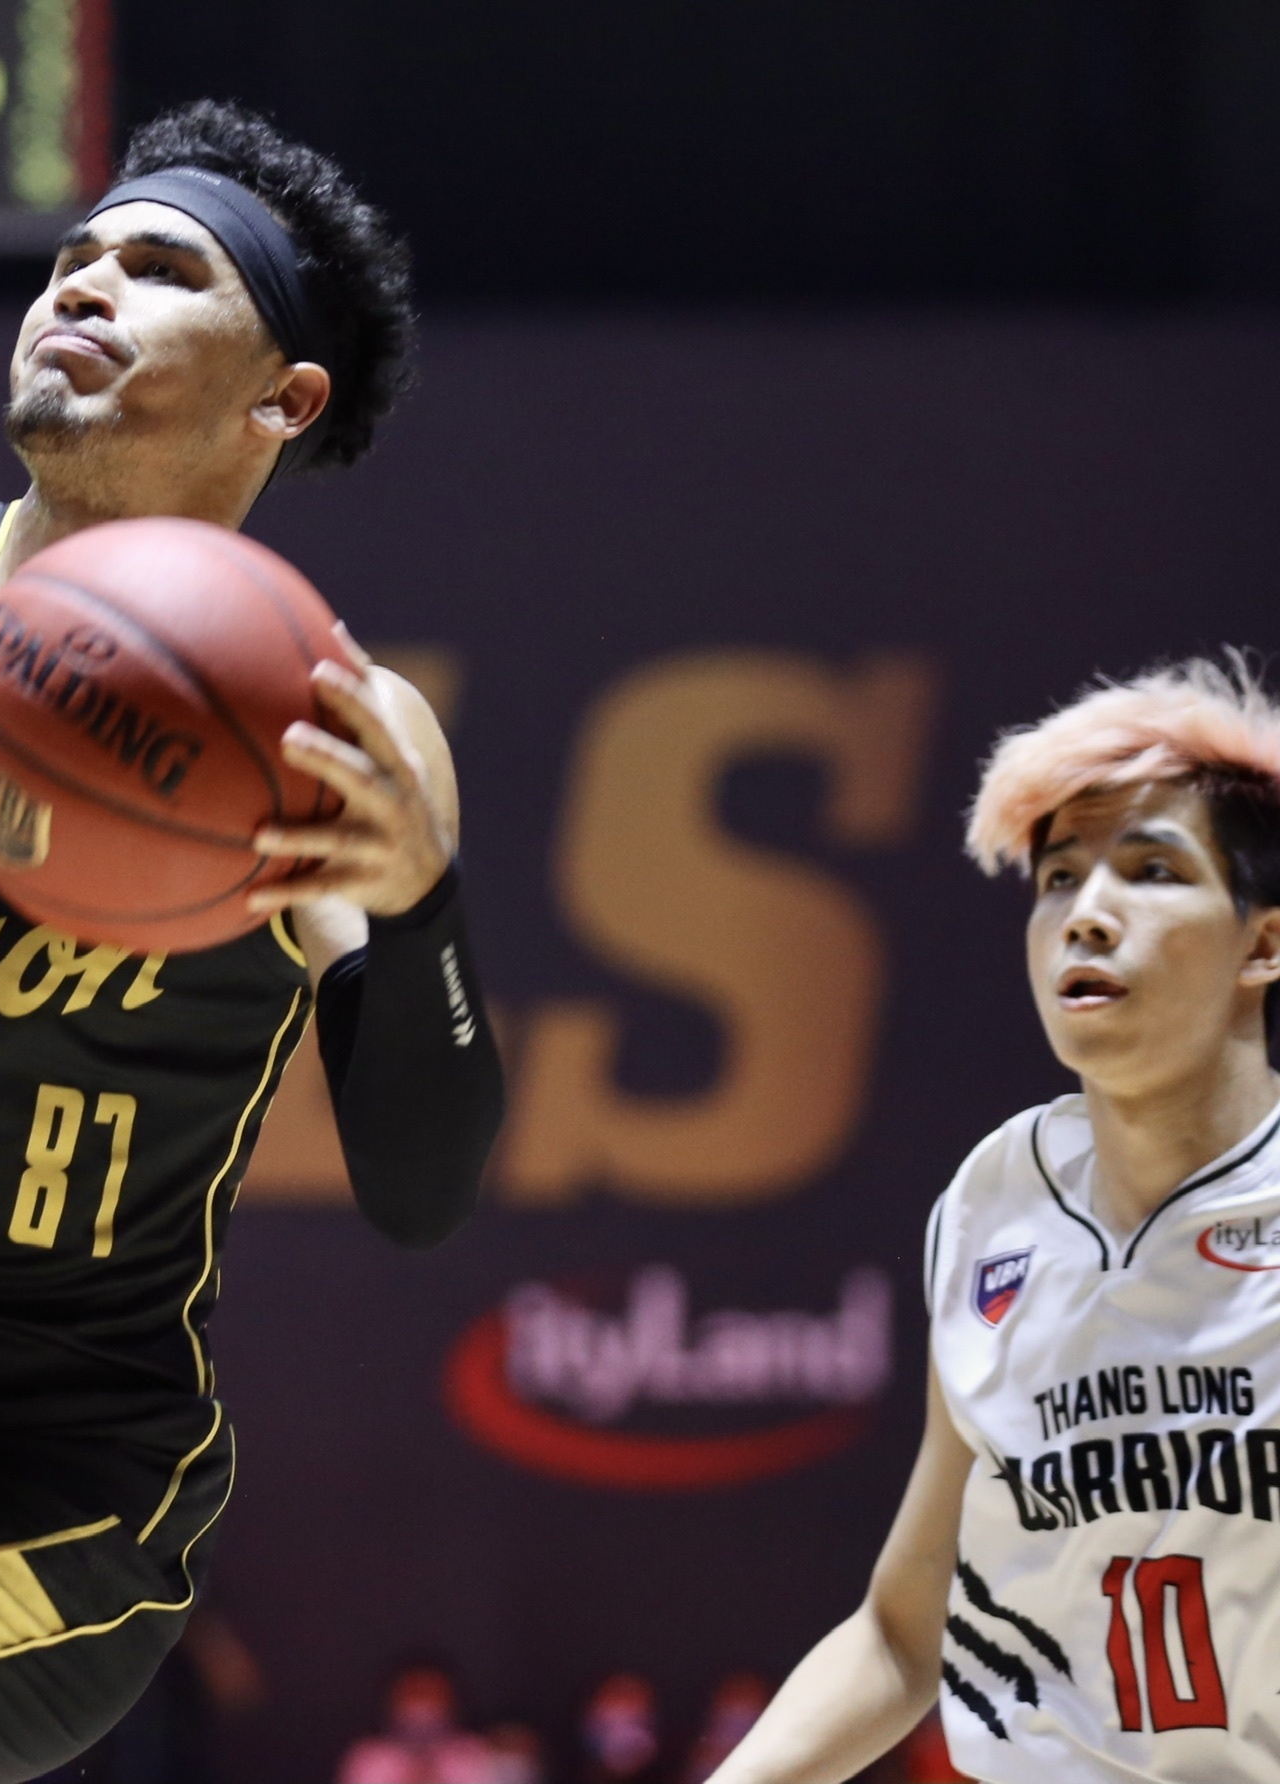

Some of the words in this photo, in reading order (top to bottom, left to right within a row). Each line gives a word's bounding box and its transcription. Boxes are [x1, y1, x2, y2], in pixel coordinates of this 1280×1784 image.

[8, 1083, 136, 1258] 87
[1034, 1365, 1147, 1441] THANG
[1158, 1365, 1255, 1417] LONG
[1102, 1554, 1230, 1734] 10
